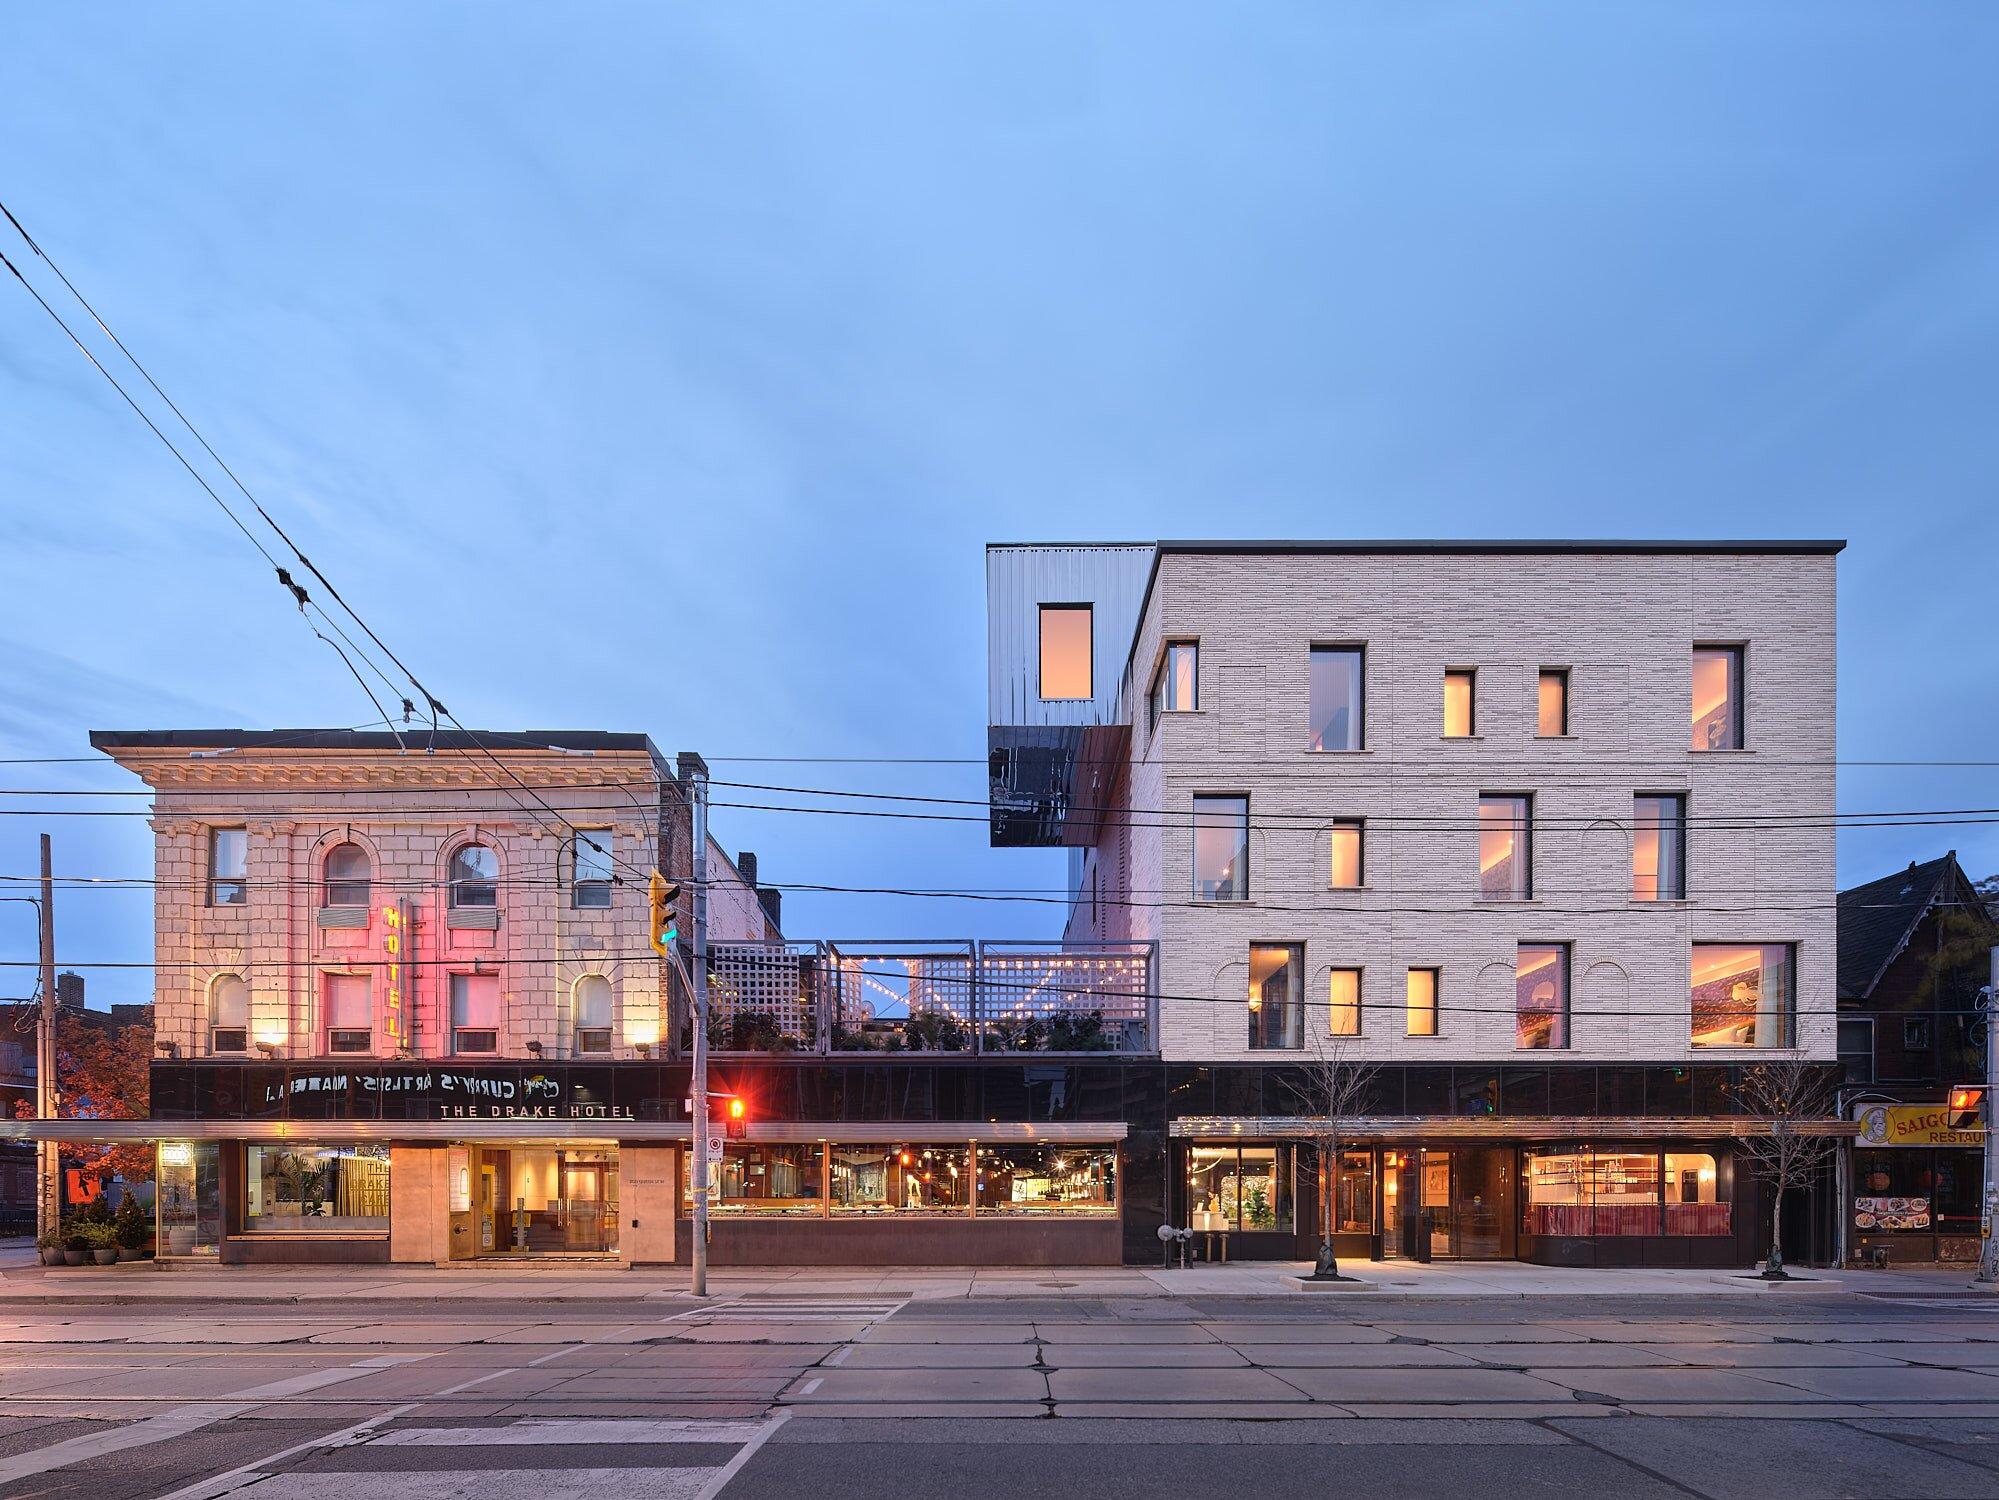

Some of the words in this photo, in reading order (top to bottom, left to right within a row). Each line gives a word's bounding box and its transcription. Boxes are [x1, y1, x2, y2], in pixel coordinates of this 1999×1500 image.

[383, 906, 400, 1038] HOTEL
[441, 1105, 478, 1118] THE
[491, 1105, 557, 1118] DRAKE
[571, 1105, 635, 1118] HOTEL
[1930, 1132, 1985, 1143] RESTAU
[367, 1163, 390, 1173] THE
